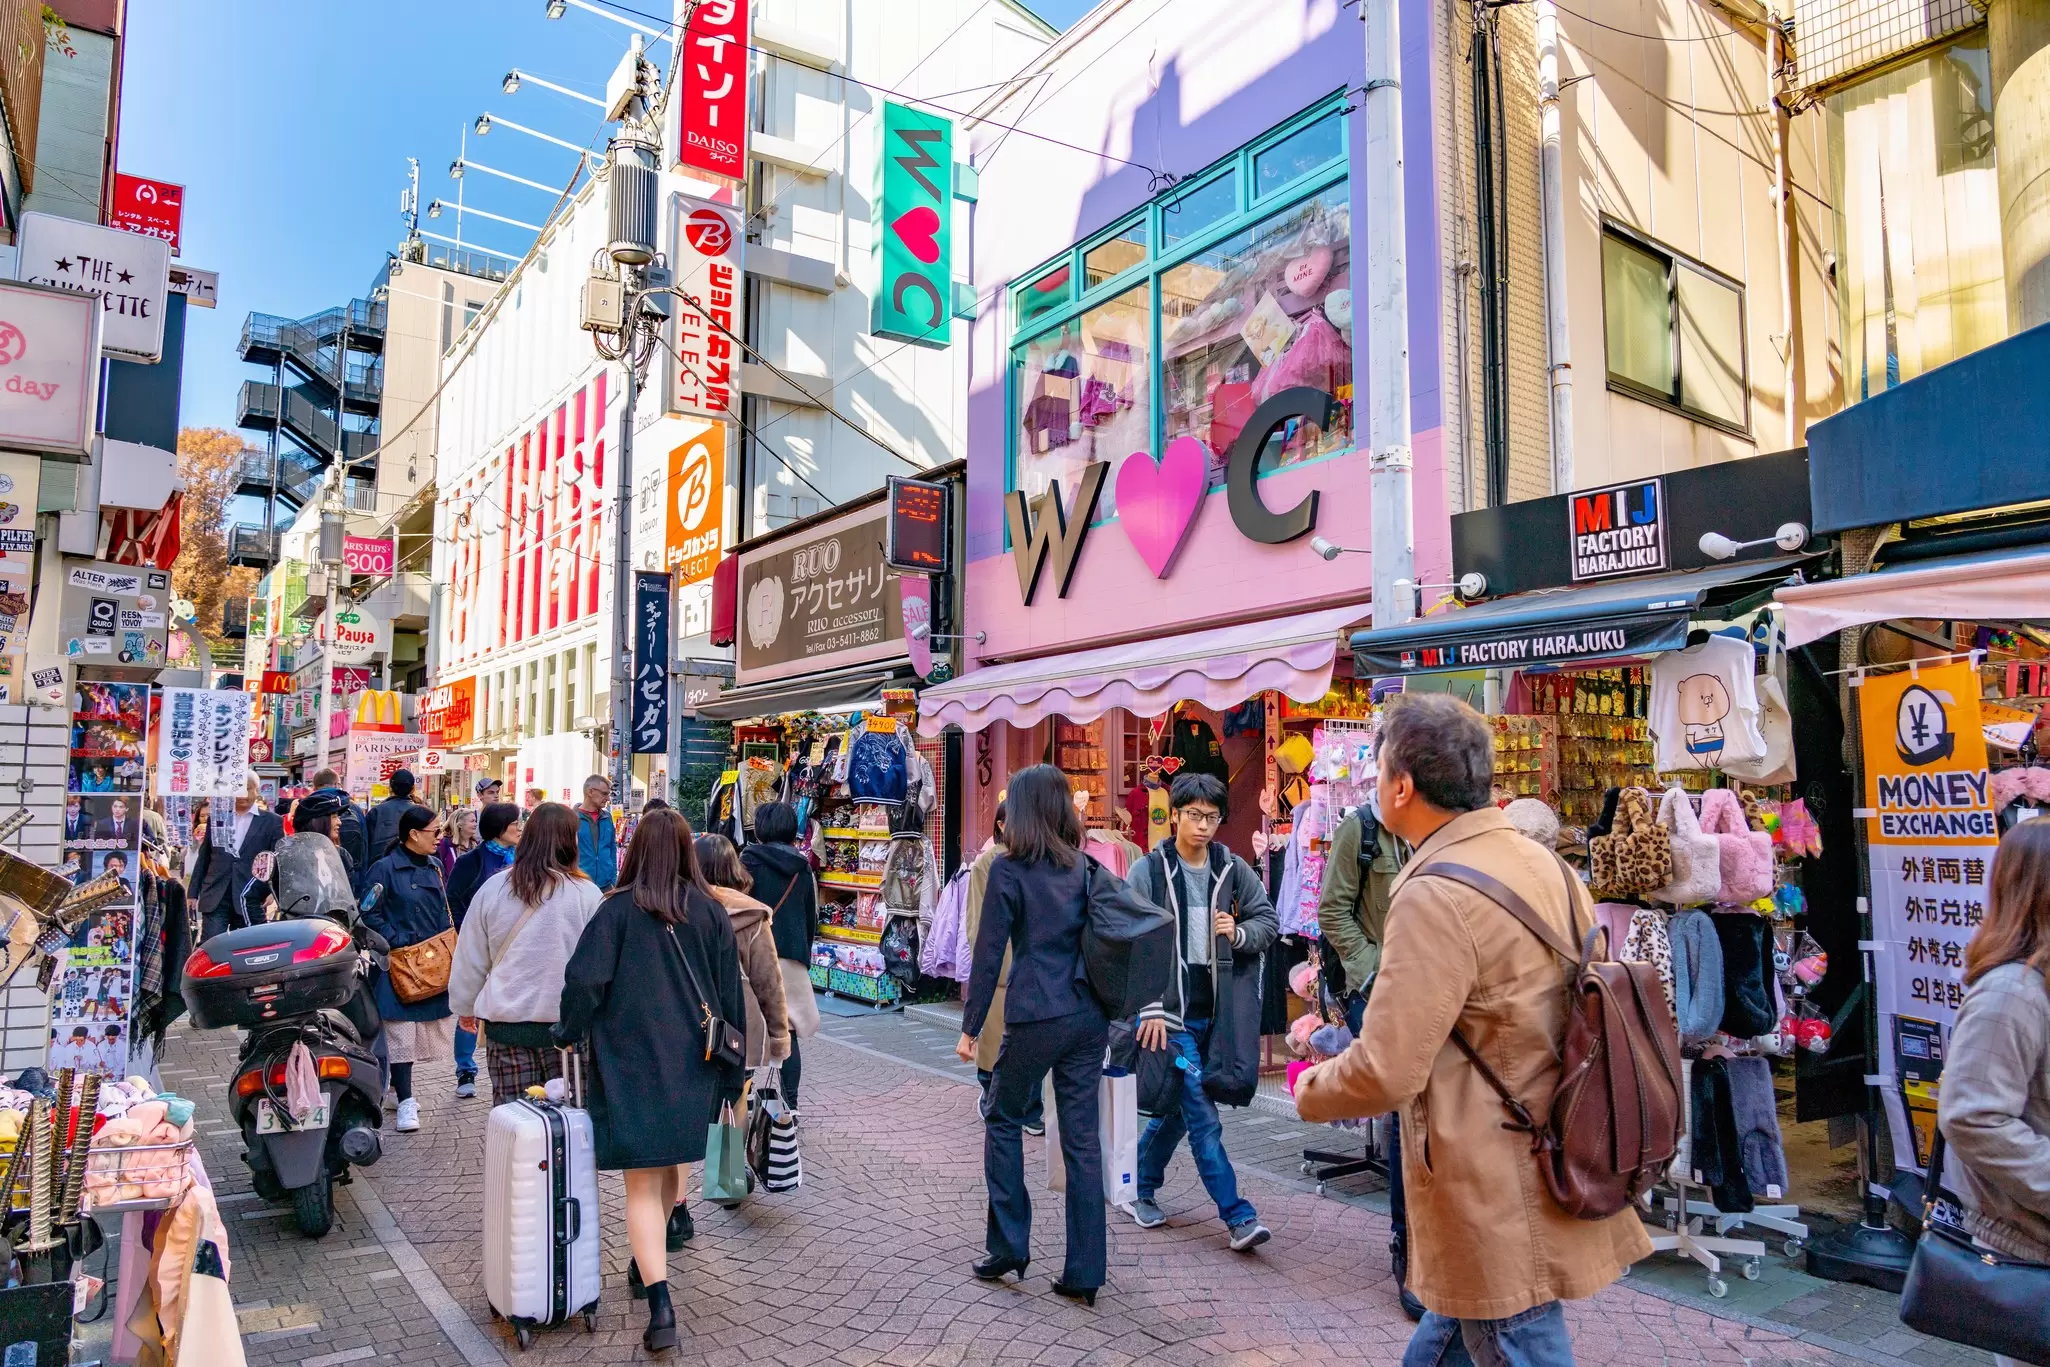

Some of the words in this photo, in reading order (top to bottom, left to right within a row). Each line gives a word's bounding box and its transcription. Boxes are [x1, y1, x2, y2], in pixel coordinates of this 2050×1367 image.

[687, 130, 738, 155] DAISO
[161, 188, 180, 198] 2F
[77, 255, 113, 284] THE
[706, 263, 732, 412] ビックカメラ
[680, 295, 701, 407] SELECT
[6, 375, 60, 401] day
[1, 530, 34, 542] PILFER
[639, 517, 659, 534] Liquor
[344, 541, 361, 551] ARIS
[362, 543, 386, 553] KID'S
[668, 528, 719, 566] ビックカメラ
[1577, 524, 1657, 556] FACTORY
[680, 555, 709, 579] ELECT
[791, 538, 841, 583] RUO
[1578, 546, 1657, 575] HARAJUKU
[73, 570, 105, 583] ALTER
[73, 577, 86, 585] Was
[790, 562, 901, 619] アクセサリー
[92, 620, 112, 628] QURO
[807, 617, 828, 634] RUO
[833, 607, 879, 628] accessory
[903, 602, 929, 623] SALE
[320, 624, 374, 643] LPausa
[645, 600, 662, 658] ギャラリー
[827, 628, 879, 649] 03-5411-8862
[1461, 638, 1530, 664] FACTORY
[1532, 630, 1625, 657] HARAJUKU
[35, 669, 57, 679] OVER
[634, 664, 666, 751] ハセガワ
[1982, 705, 2025, 720] SALE
[418, 712, 442, 734] SELECT
[868, 718, 895, 730] ¥4900
[355, 743, 391, 753] PARIS
[1879, 771, 1987, 808] MONEY
[1882, 812, 1994, 836] EXCHANGE
[1902, 856, 1985, 885] 外貨両替
[1908, 936, 1967, 968] 外幣兌
